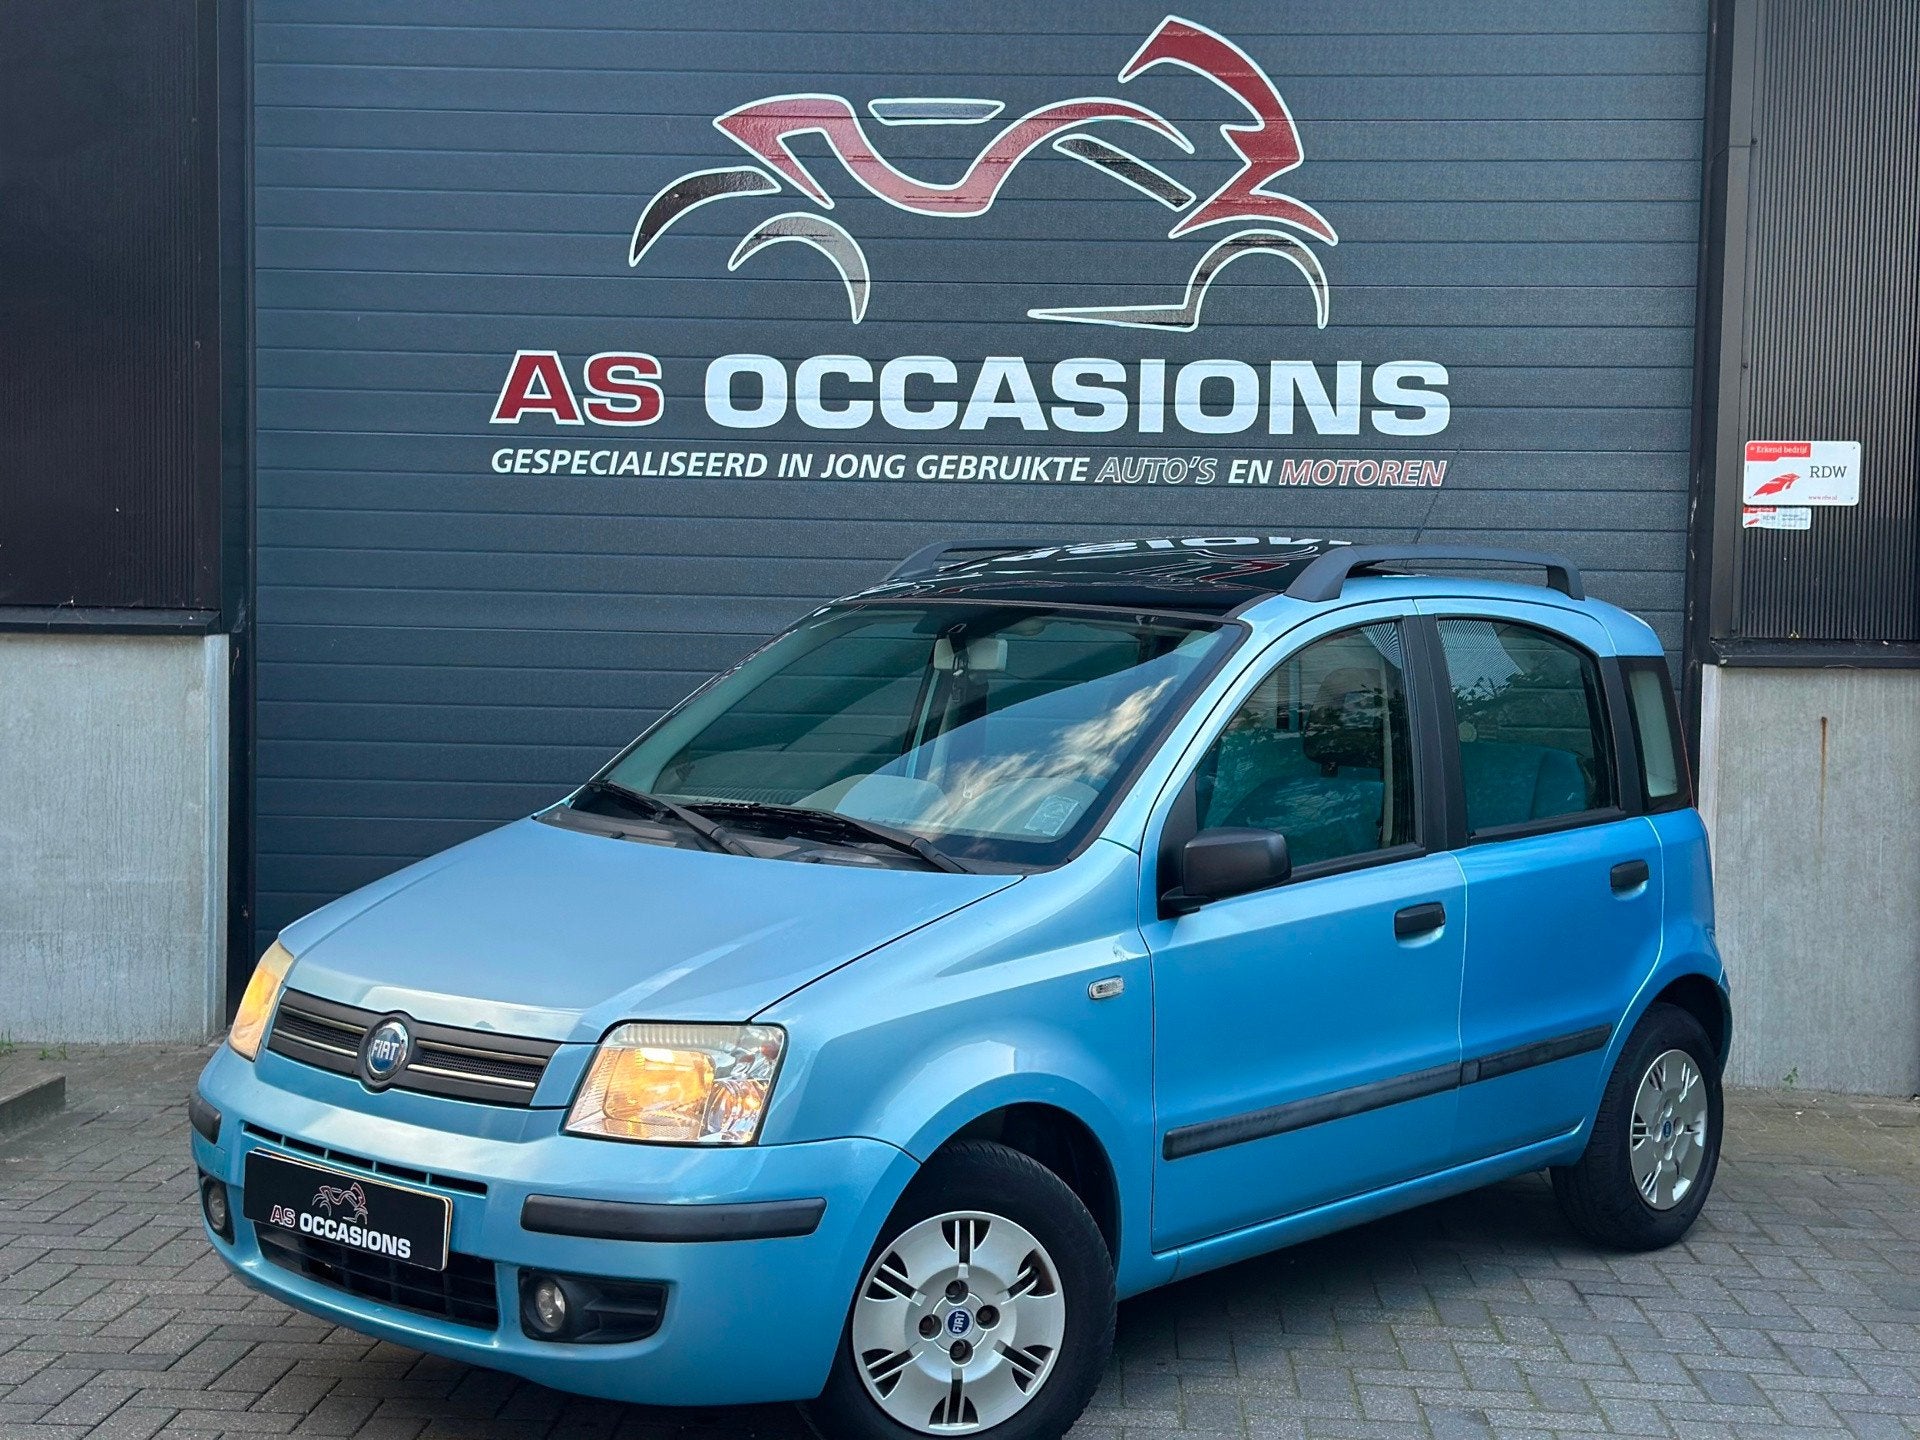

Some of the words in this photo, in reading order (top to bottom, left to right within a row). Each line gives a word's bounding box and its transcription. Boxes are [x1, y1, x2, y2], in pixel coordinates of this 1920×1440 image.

[489, 348, 665, 428] AS
[704, 353, 1451, 436] OCCASIONS
[491, 447, 768, 478] GESPECIALISEERD
[777, 452, 814, 479] IN
[820, 452, 906, 481] JONG
[916, 453, 1090, 483] GEBRUIKTE
[1095, 456, 1218, 485] AUTO'S
[1228, 459, 1274, 484] EN
[1278, 459, 1448, 488] MOTOREN
[1809, 465, 1847, 478] RDW
[371, 1039, 400, 1061] FIAT
[270, 1204, 296, 1228] AS
[299, 1212, 411, 1259] OCCASIONS
[952, 1312, 965, 1333] FIAT
